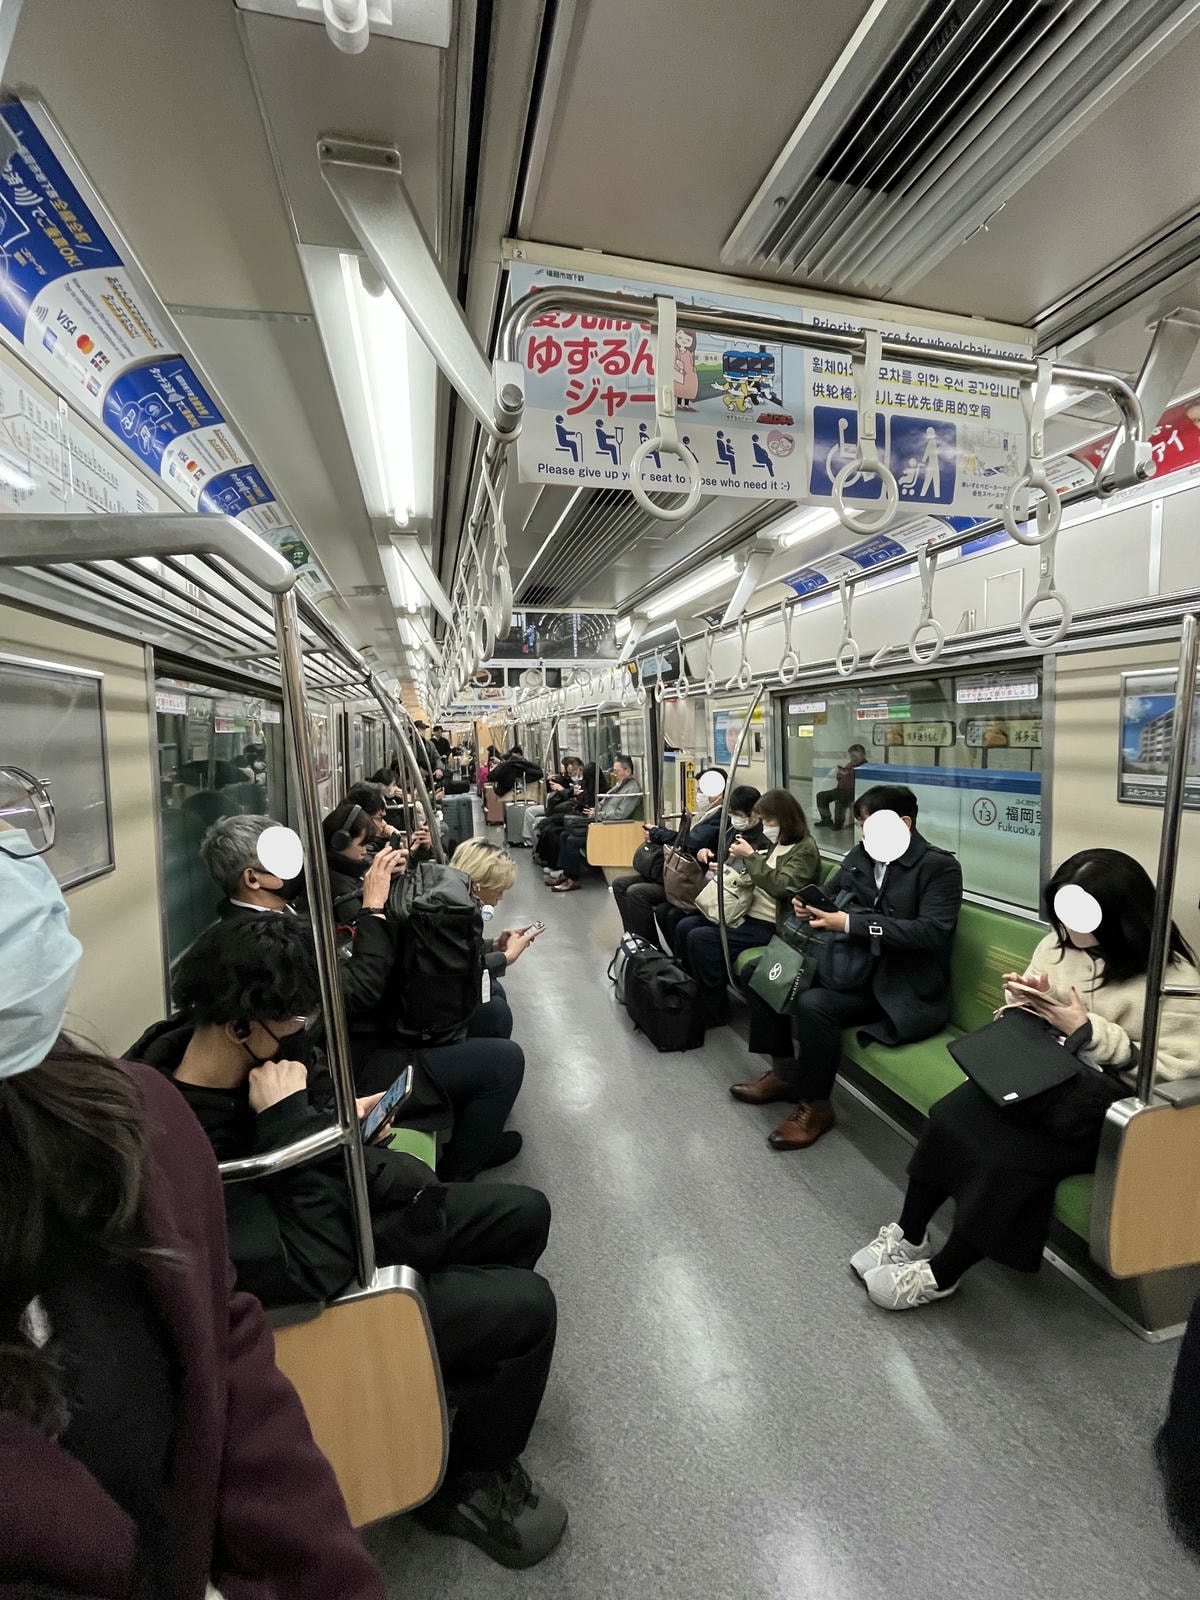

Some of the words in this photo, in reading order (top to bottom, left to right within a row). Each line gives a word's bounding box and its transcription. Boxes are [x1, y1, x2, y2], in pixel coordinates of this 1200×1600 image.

[56, 309, 77, 336] VISA
[527, 335, 655, 375] ゆずるん
[878, 367, 912, 385] 모차를
[917, 372, 940, 388] 위한
[944, 376, 964, 392] 우선
[812, 382, 991, 419] 供轮椅儿车优先使用的空间
[538, 463, 575, 476] Please
[578, 466, 601, 478] give
[604, 470, 618, 480] up
[650, 474, 672, 483] seat
[676, 474, 686, 484] to
[720, 478, 740, 488] who
[744, 480, 768, 490] need
[770, 480, 778, 490] it
[978, 810, 992, 822] 13
[982, 802, 988, 810] K
[998, 822, 1036, 836] Fukuoka
